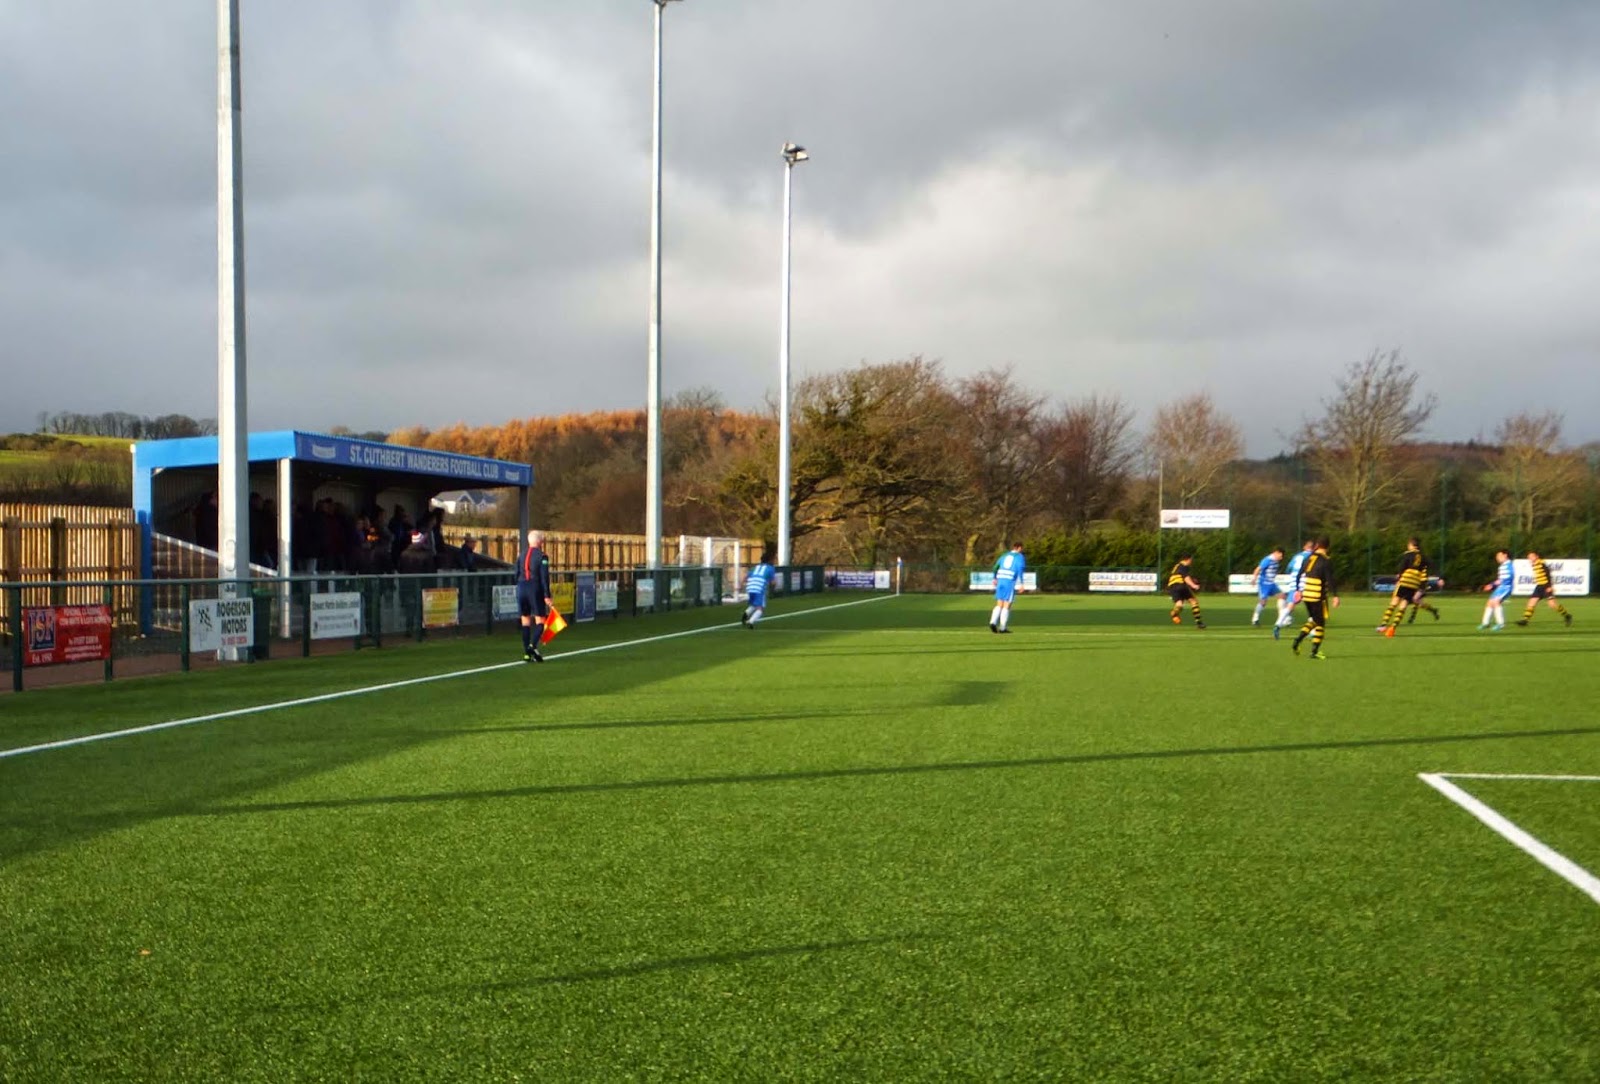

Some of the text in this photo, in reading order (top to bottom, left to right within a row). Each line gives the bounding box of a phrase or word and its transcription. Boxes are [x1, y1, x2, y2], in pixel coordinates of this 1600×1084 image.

[350, 445, 362, 463] ST.
[364, 447, 405, 468] CUTHBERT
[407, 452, 449, 473] WANDERERS
[450, 458, 482, 477] FOOTBALL
[483, 462, 499, 479] CLUB
[1518, 575, 1584, 585] ENGERING
[216, 601, 251, 617] ROGERSON
[221, 618, 247, 634] MOTORS
